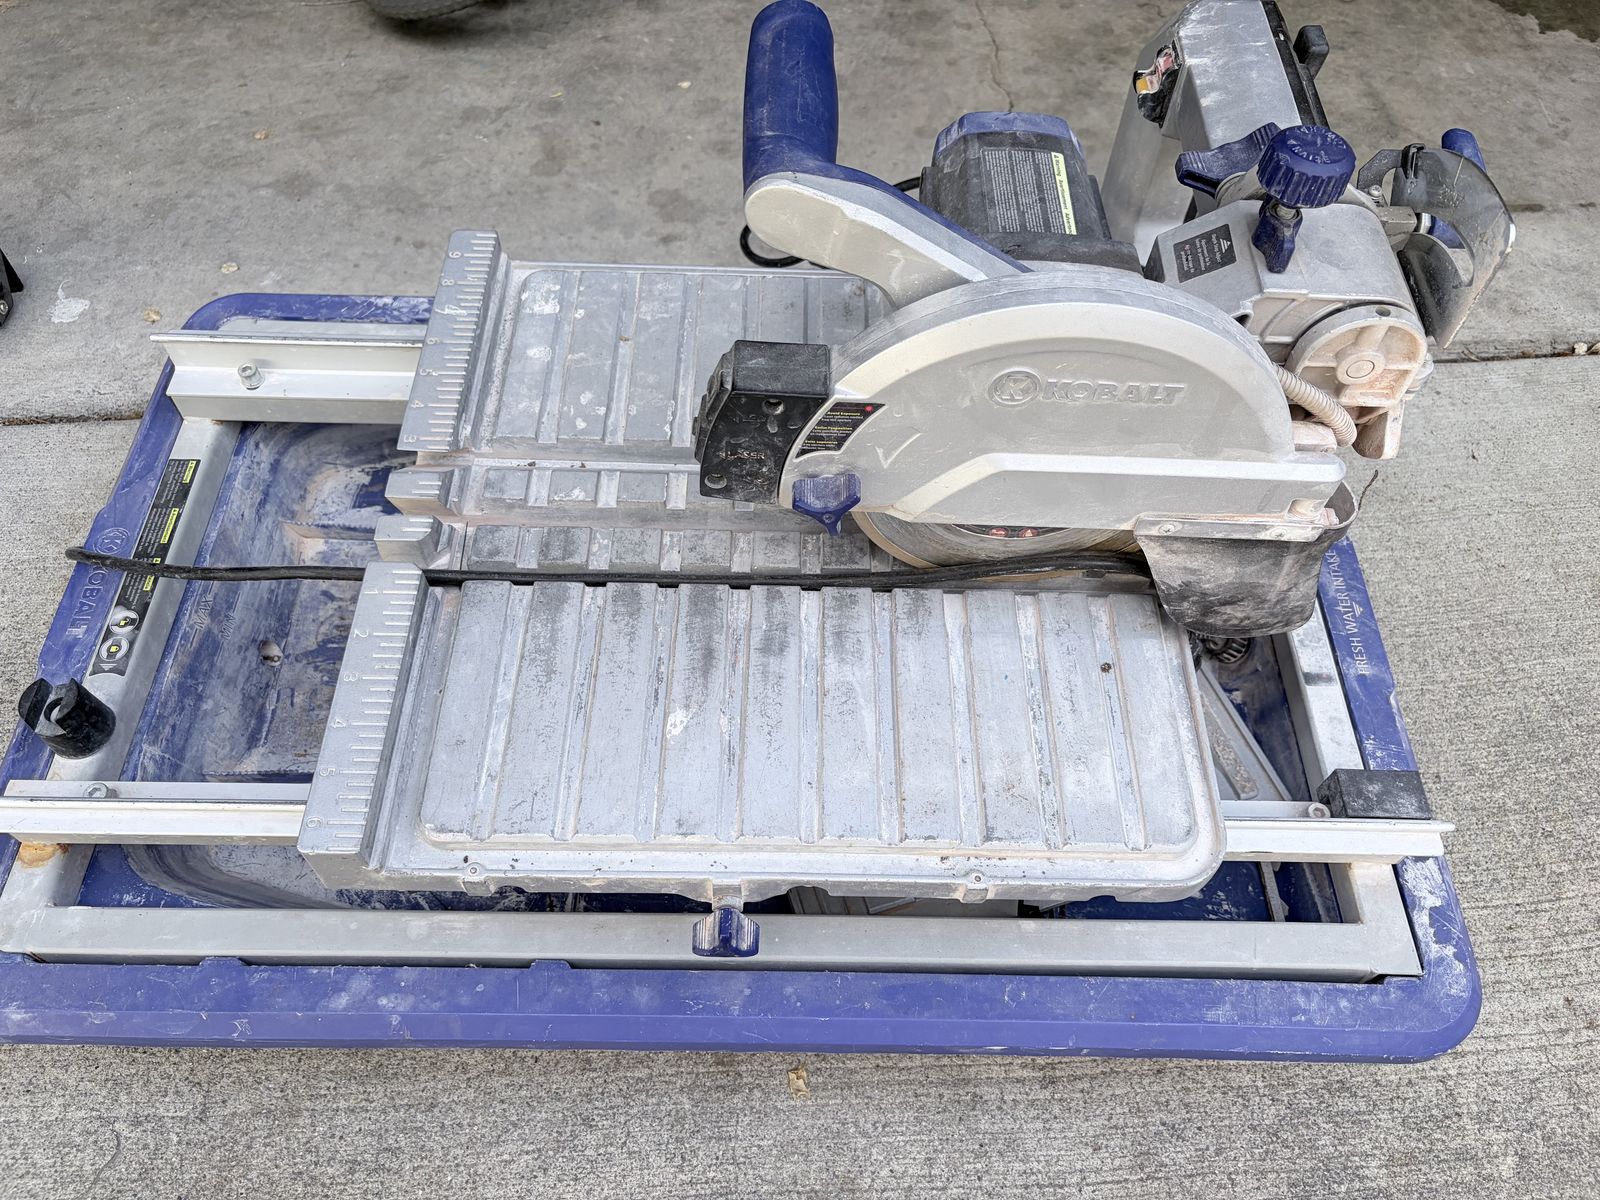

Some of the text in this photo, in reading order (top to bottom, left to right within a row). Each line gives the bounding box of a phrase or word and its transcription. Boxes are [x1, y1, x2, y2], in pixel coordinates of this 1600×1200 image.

[427, 337, 440, 345] 6
[1042, 379, 1185, 405] KOBALT
[411, 400, 424, 408] 4
[404, 434, 417, 442] 3
[727, 450, 765, 460] LASER
[194, 594, 213, 629] MAX
[1325, 549, 1370, 674] FRESH WATER INTAKE
[220, 612, 236, 640] MIN
[354, 629, 369, 638] 2
[343, 672, 358, 682] 3
[331, 718, 347, 729] 4
[319, 767, 336, 777] 5
[306, 816, 323, 829] 6
